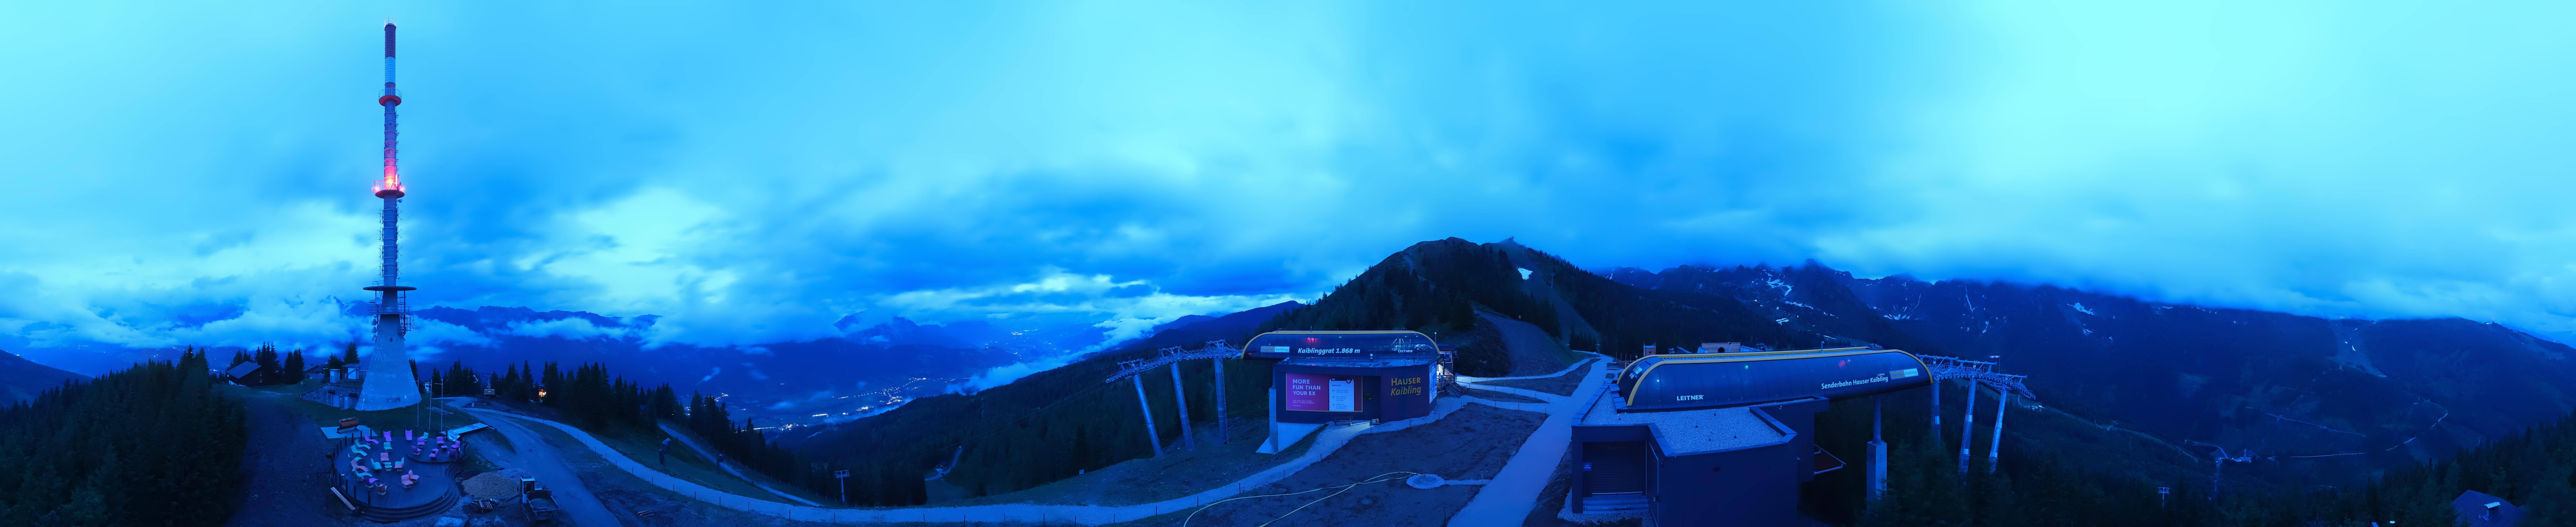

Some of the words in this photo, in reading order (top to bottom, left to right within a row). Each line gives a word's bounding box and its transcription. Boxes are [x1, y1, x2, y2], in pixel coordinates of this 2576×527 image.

[1391, 377, 1421, 386] HAUSER
[1821, 380, 1852, 389] Senderbahn
[1391, 386, 1421, 396] Kaibling
